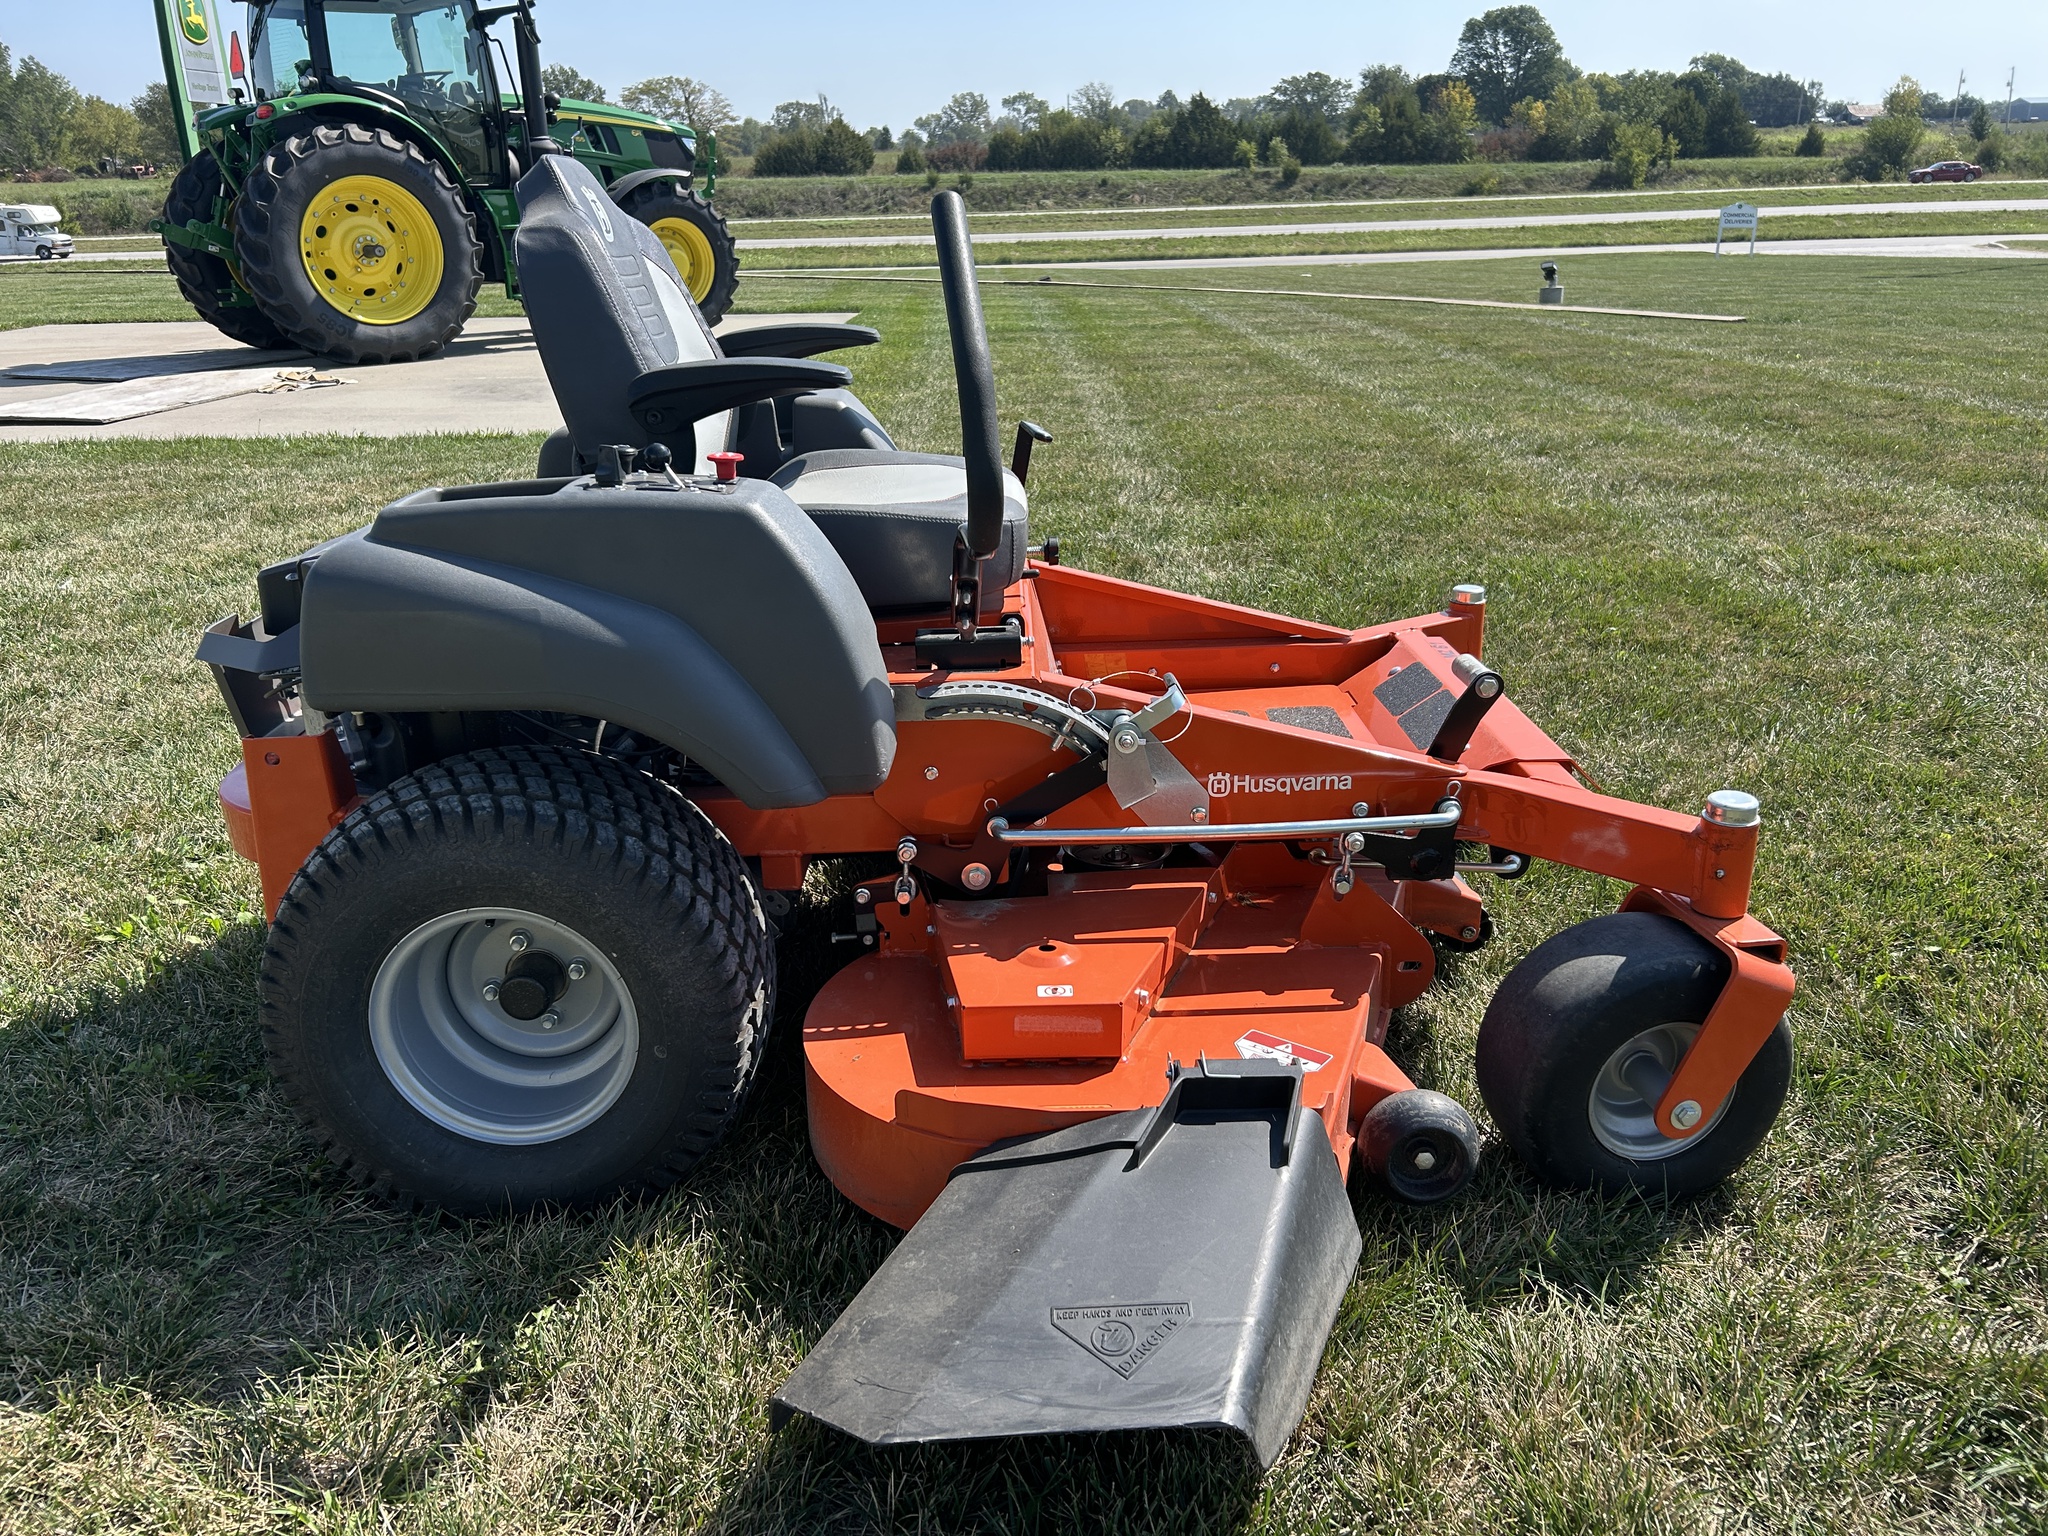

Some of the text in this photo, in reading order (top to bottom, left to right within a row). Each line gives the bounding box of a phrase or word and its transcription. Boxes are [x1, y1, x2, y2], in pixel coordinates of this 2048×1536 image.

[1233, 774, 1352, 795] Husqvarna
[1056, 1305, 1186, 1320] KEEP HANDS AND FEET AWAY
[1118, 1317, 1178, 1373] DANGER
